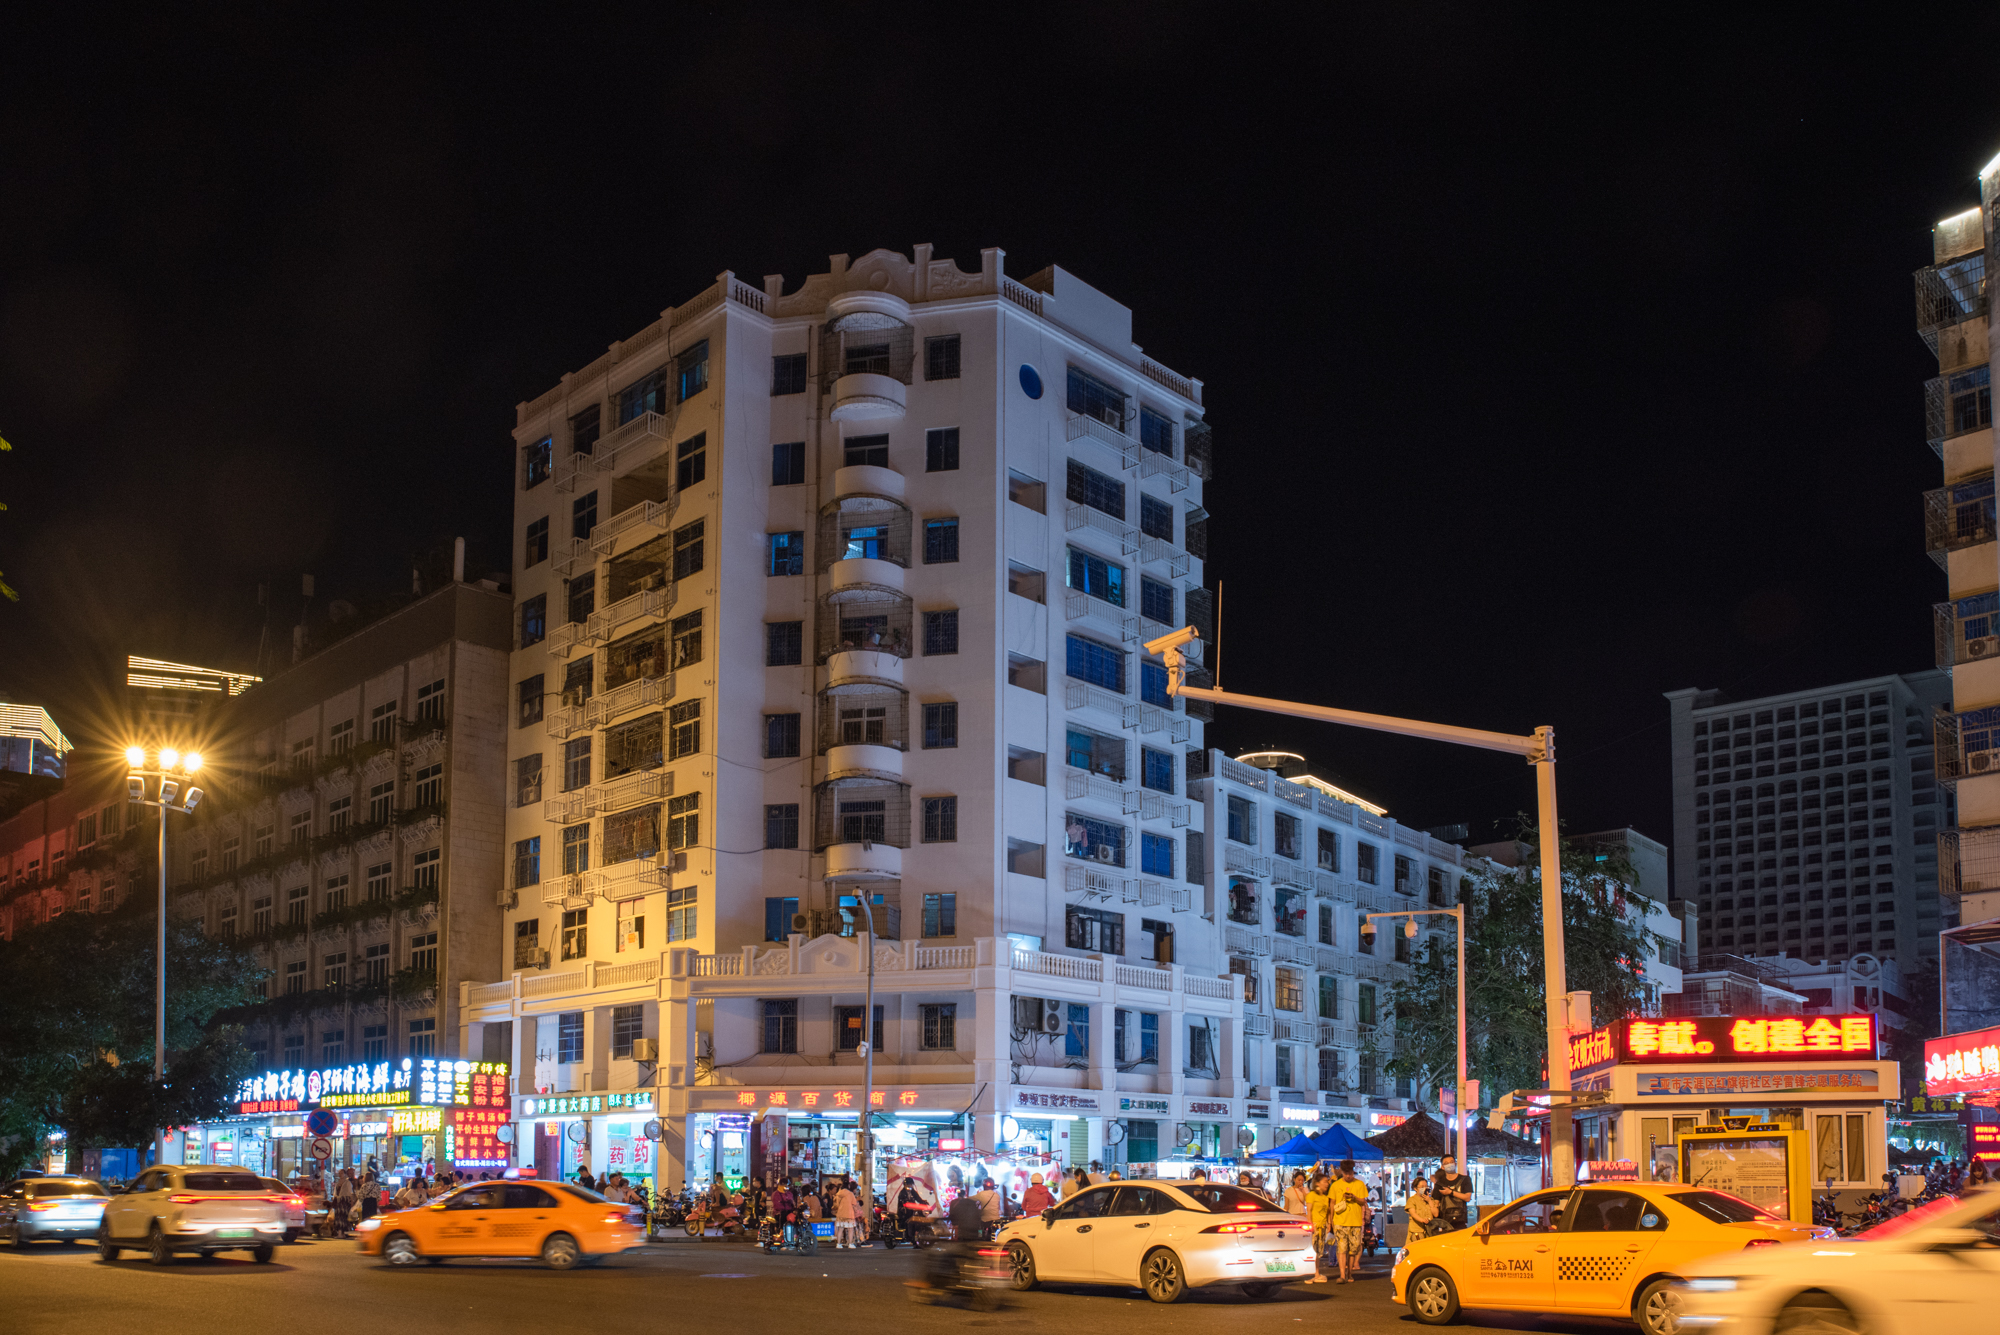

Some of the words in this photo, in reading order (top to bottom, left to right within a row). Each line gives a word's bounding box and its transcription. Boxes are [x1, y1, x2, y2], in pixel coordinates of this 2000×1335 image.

[1729, 1018, 1871, 1053] 创建全国
[470, 1062, 507, 1076] 罗师傅
[1946, 1044, 2000, 1080] 绝味鸭
[473, 1074, 487, 1105] 后安粉
[1649, 1074, 1862, 1090] 三亚市天涯区红旗街社区学雷锋志愿服务站
[491, 1075, 505, 1107] 抱罗粉
[738, 1091, 919, 1106] 椰源百货商行
[538, 1096, 601, 1113] 仲景堂大药房
[455, 1123, 501, 1135] 平价生猛海
[609, 1146, 624, 1164] 药
[634, 1135, 649, 1163] 药
[1508, 1260, 1533, 1271] TAXI
